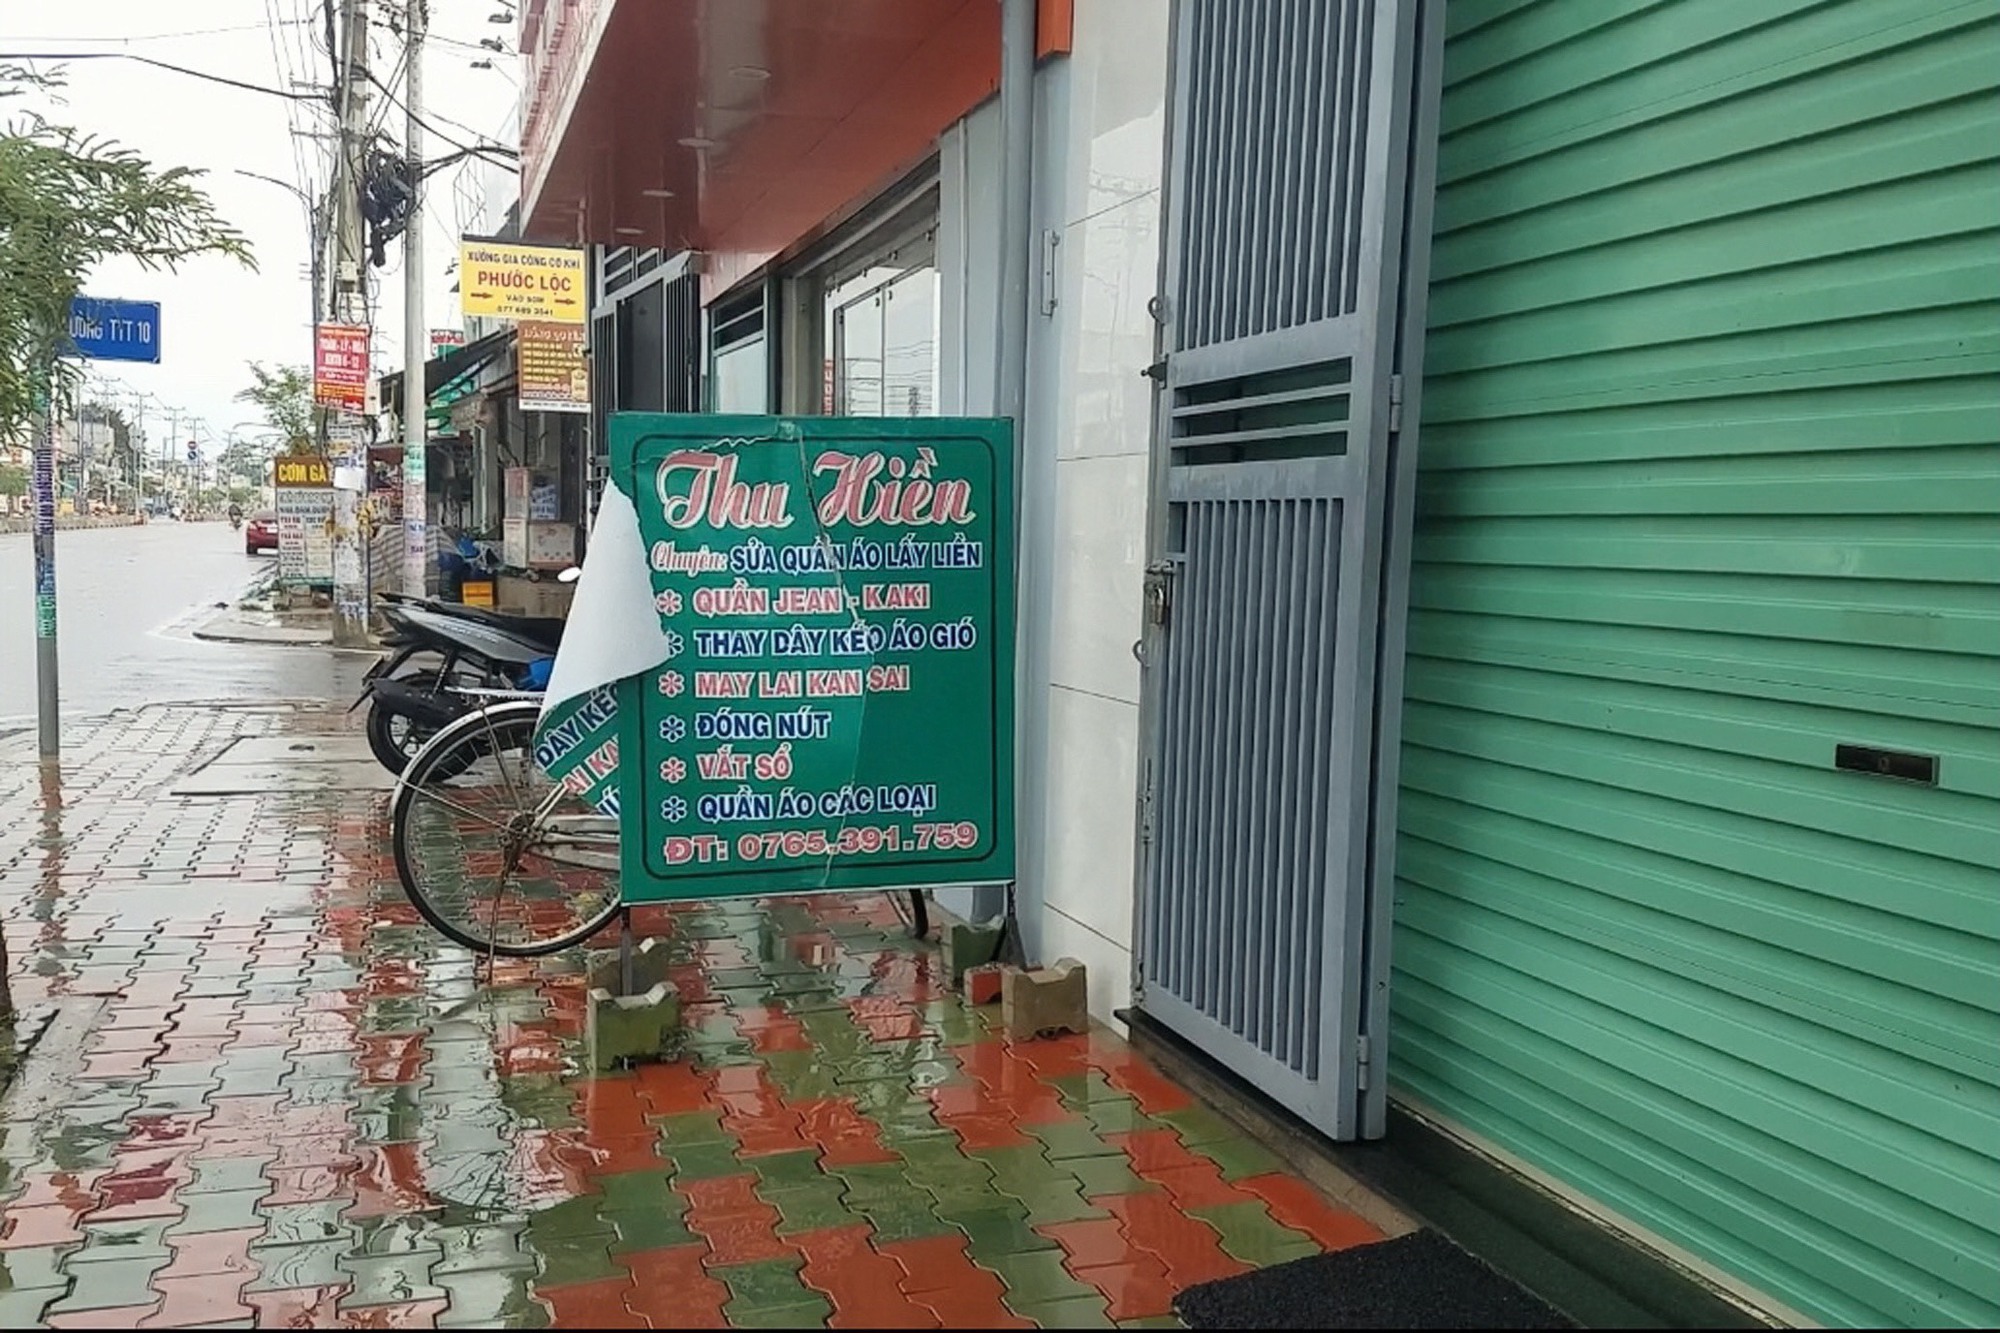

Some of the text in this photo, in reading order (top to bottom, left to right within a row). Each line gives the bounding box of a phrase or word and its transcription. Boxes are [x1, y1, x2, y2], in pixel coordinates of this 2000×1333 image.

[503, 254, 519, 264] GIA
[520, 254, 547, 267] CÔNG
[478, 269, 571, 296] PHƯỚC LỘC
[69, 310, 103, 339] ƯỜNG
[137, 321, 151, 343] 10
[279, 462, 307, 481] CƠM
[310, 461, 327, 481] GÀ
[656, 447, 977, 530] Thu Hiền
[730, 536, 778, 573] SỬA
[780, 532, 846, 575] QUẦN
[851, 536, 882, 570] ÁO
[885, 532, 930, 568] LẤY
[932, 532, 983, 568] LIỀN
[693, 577, 769, 618] QUẦN
[773, 587, 843, 615] JEAN
[863, 583, 931, 610] KAKI
[694, 616, 977, 657] THAY DÂY KÉO ÁO GIÓ
[695, 665, 910, 698] MAY LAI KAN SAI
[695, 705, 832, 739] ĐÓNG NÚT
[695, 741, 793, 780] VẮT SỔ
[698, 782, 936, 824] QUẦN ÁO CÁC LOẠI
[664, 821, 979, 865] ĐT: 0765.391.759
